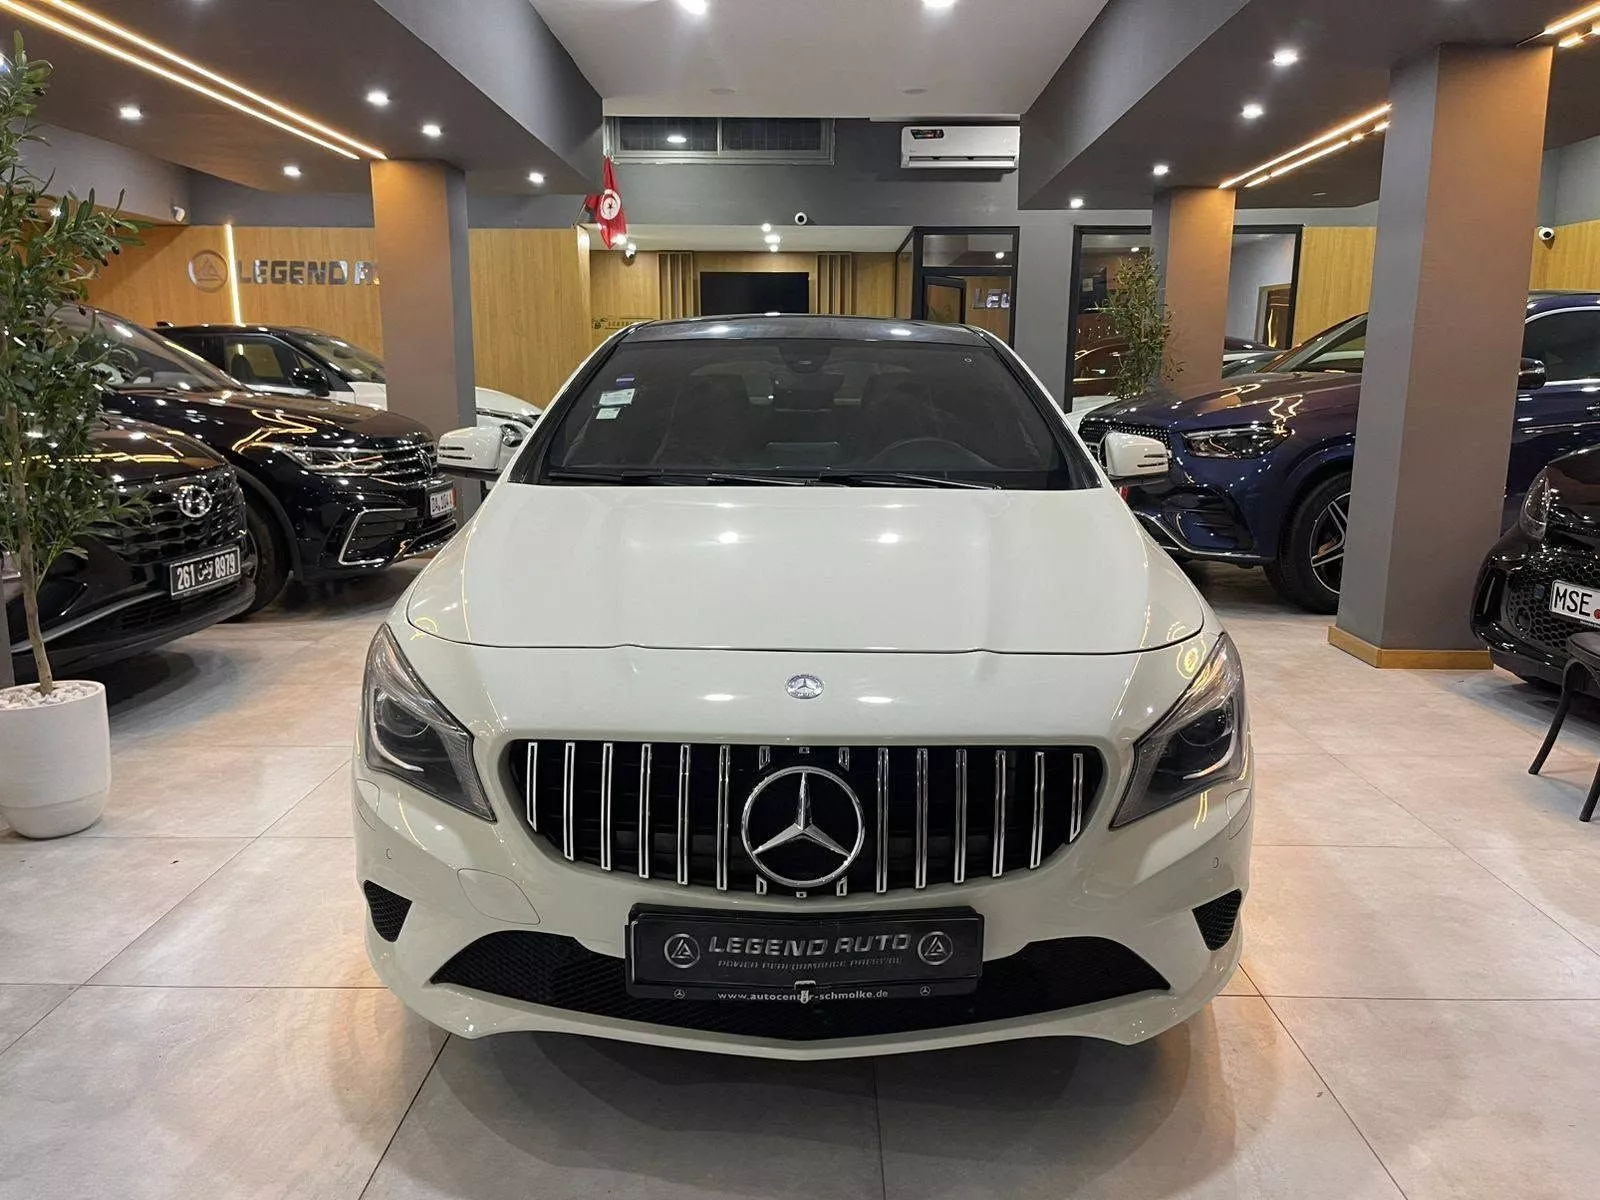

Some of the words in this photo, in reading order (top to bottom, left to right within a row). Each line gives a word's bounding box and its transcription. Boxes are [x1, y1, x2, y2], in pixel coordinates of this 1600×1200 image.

[238, 260, 348, 285] LEGEND
[354, 260, 380, 285] A
[177, 564, 196, 590] 261
[214, 553, 236, 578] 8979
[1555, 587, 1592, 616] MSE
[708, 936, 828, 956] LEGEND
[834, 934, 912, 954] AUTO
